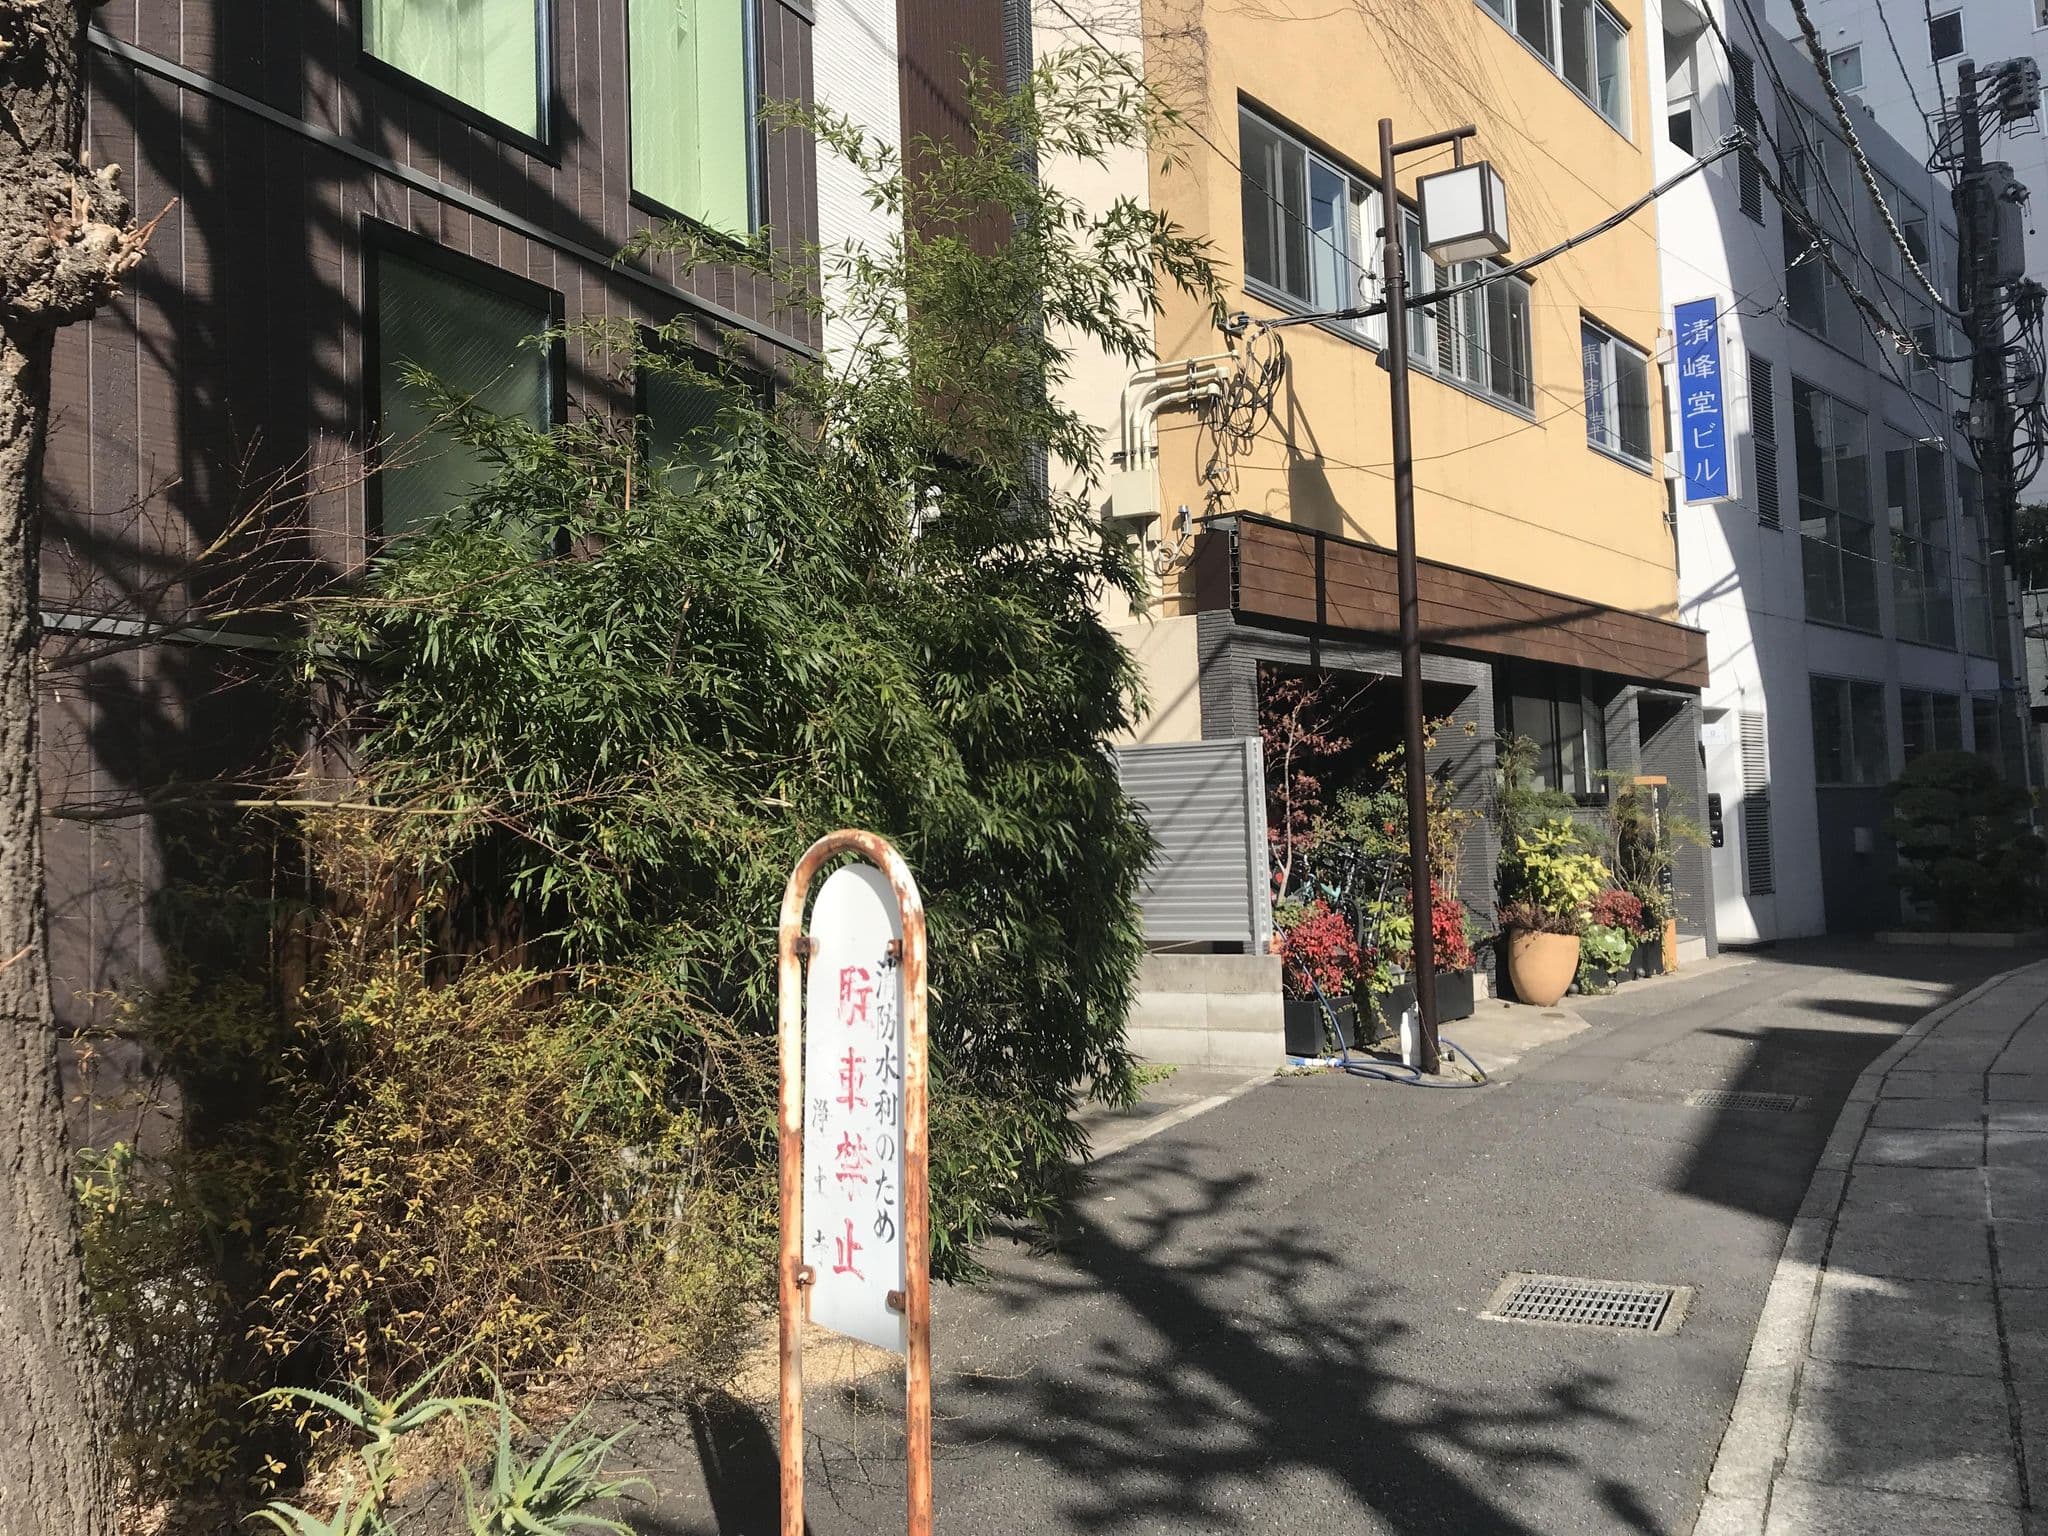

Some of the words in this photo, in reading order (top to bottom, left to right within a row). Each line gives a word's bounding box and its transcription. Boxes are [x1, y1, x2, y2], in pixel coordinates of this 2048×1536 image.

[1681, 318, 1721, 482] 清峰堂ビル
[874, 958, 900, 1244] 消防水利のため
